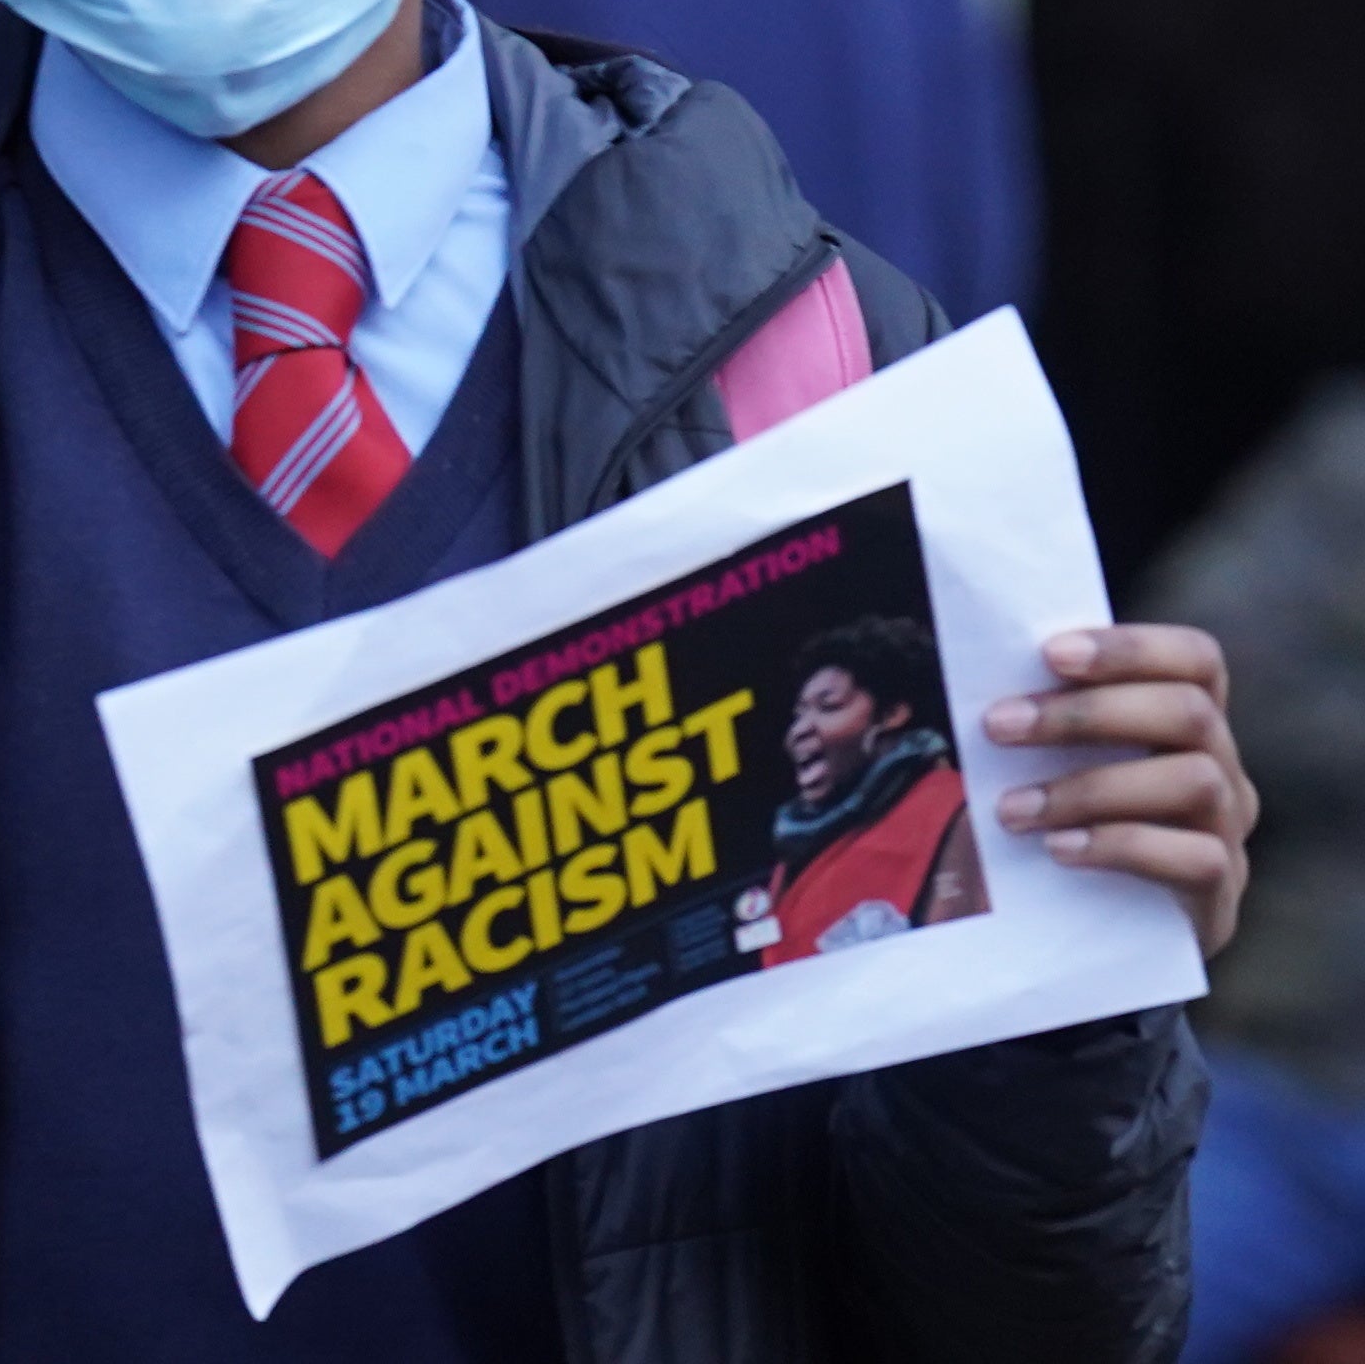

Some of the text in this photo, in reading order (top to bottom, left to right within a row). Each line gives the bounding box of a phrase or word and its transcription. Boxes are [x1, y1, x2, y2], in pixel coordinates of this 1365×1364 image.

[275, 524, 843, 799] NATIONAL DEMONSTRATION
[283, 641, 674, 884] MARCH
[301, 688, 755, 972] AGAINST
[313, 799, 717, 1049] RACISM
[329, 980, 539, 1103] SATURDAY
[332, 1016, 540, 1135] 19 MARCH
